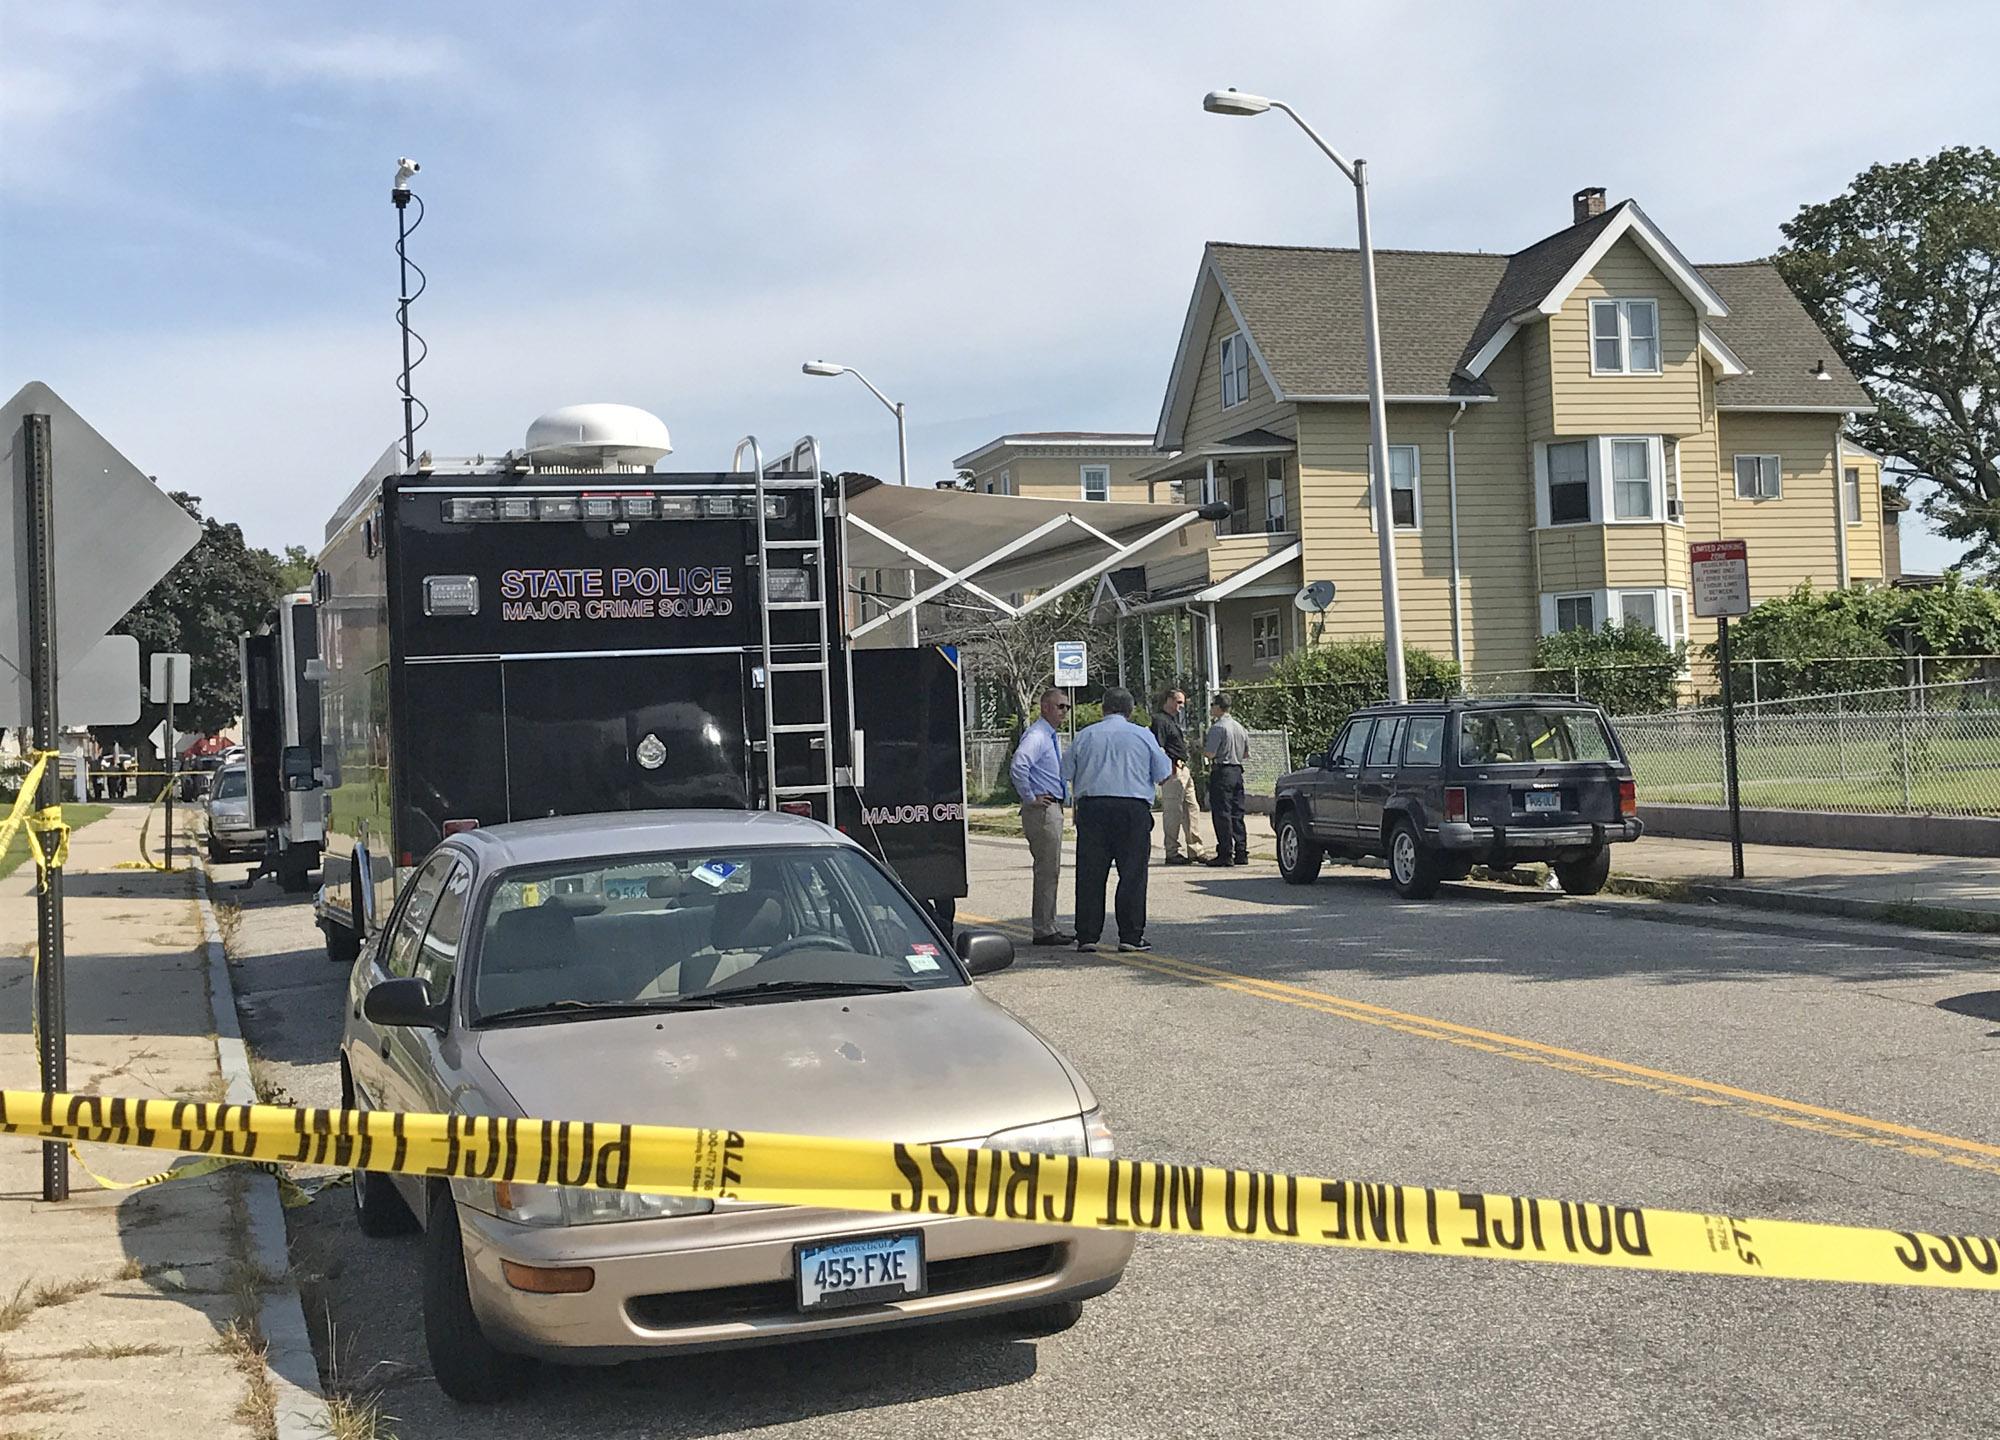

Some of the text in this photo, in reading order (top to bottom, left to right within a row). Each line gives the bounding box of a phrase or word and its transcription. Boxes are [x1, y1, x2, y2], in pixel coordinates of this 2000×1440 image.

[1692, 544, 1716, 554] LIMITED
[501, 566, 733, 598] STATE POLICE
[503, 597, 733, 621] MAJOR CRIME SQUAD
[862, 802, 966, 825] MAJOR CRI
[891, 1142, 1079, 1222] CROSS
[1096, 1158, 1204, 1231] NOT
[1225, 1168, 1300, 1237] DO
[1321, 1179, 1442, 1247] LINE
[1458, 1192, 1654, 1257] POLICE
